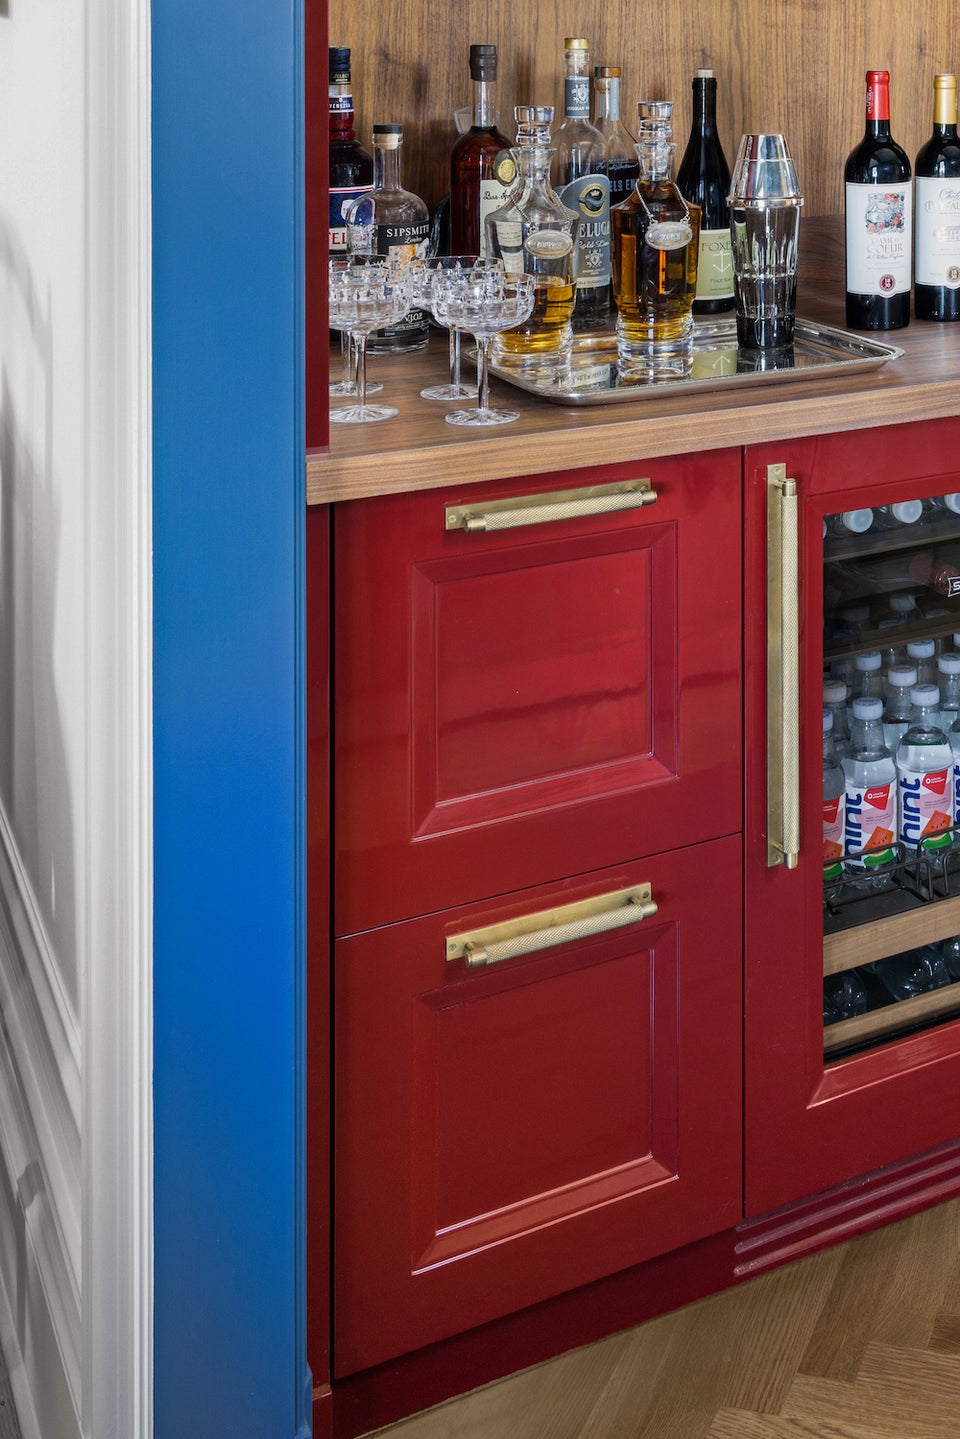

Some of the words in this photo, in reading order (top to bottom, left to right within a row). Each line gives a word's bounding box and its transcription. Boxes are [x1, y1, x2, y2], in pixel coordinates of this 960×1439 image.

[866, 244, 904, 254] COEUR
[845, 793, 862, 862] hint
[900, 777, 921, 845] hint
